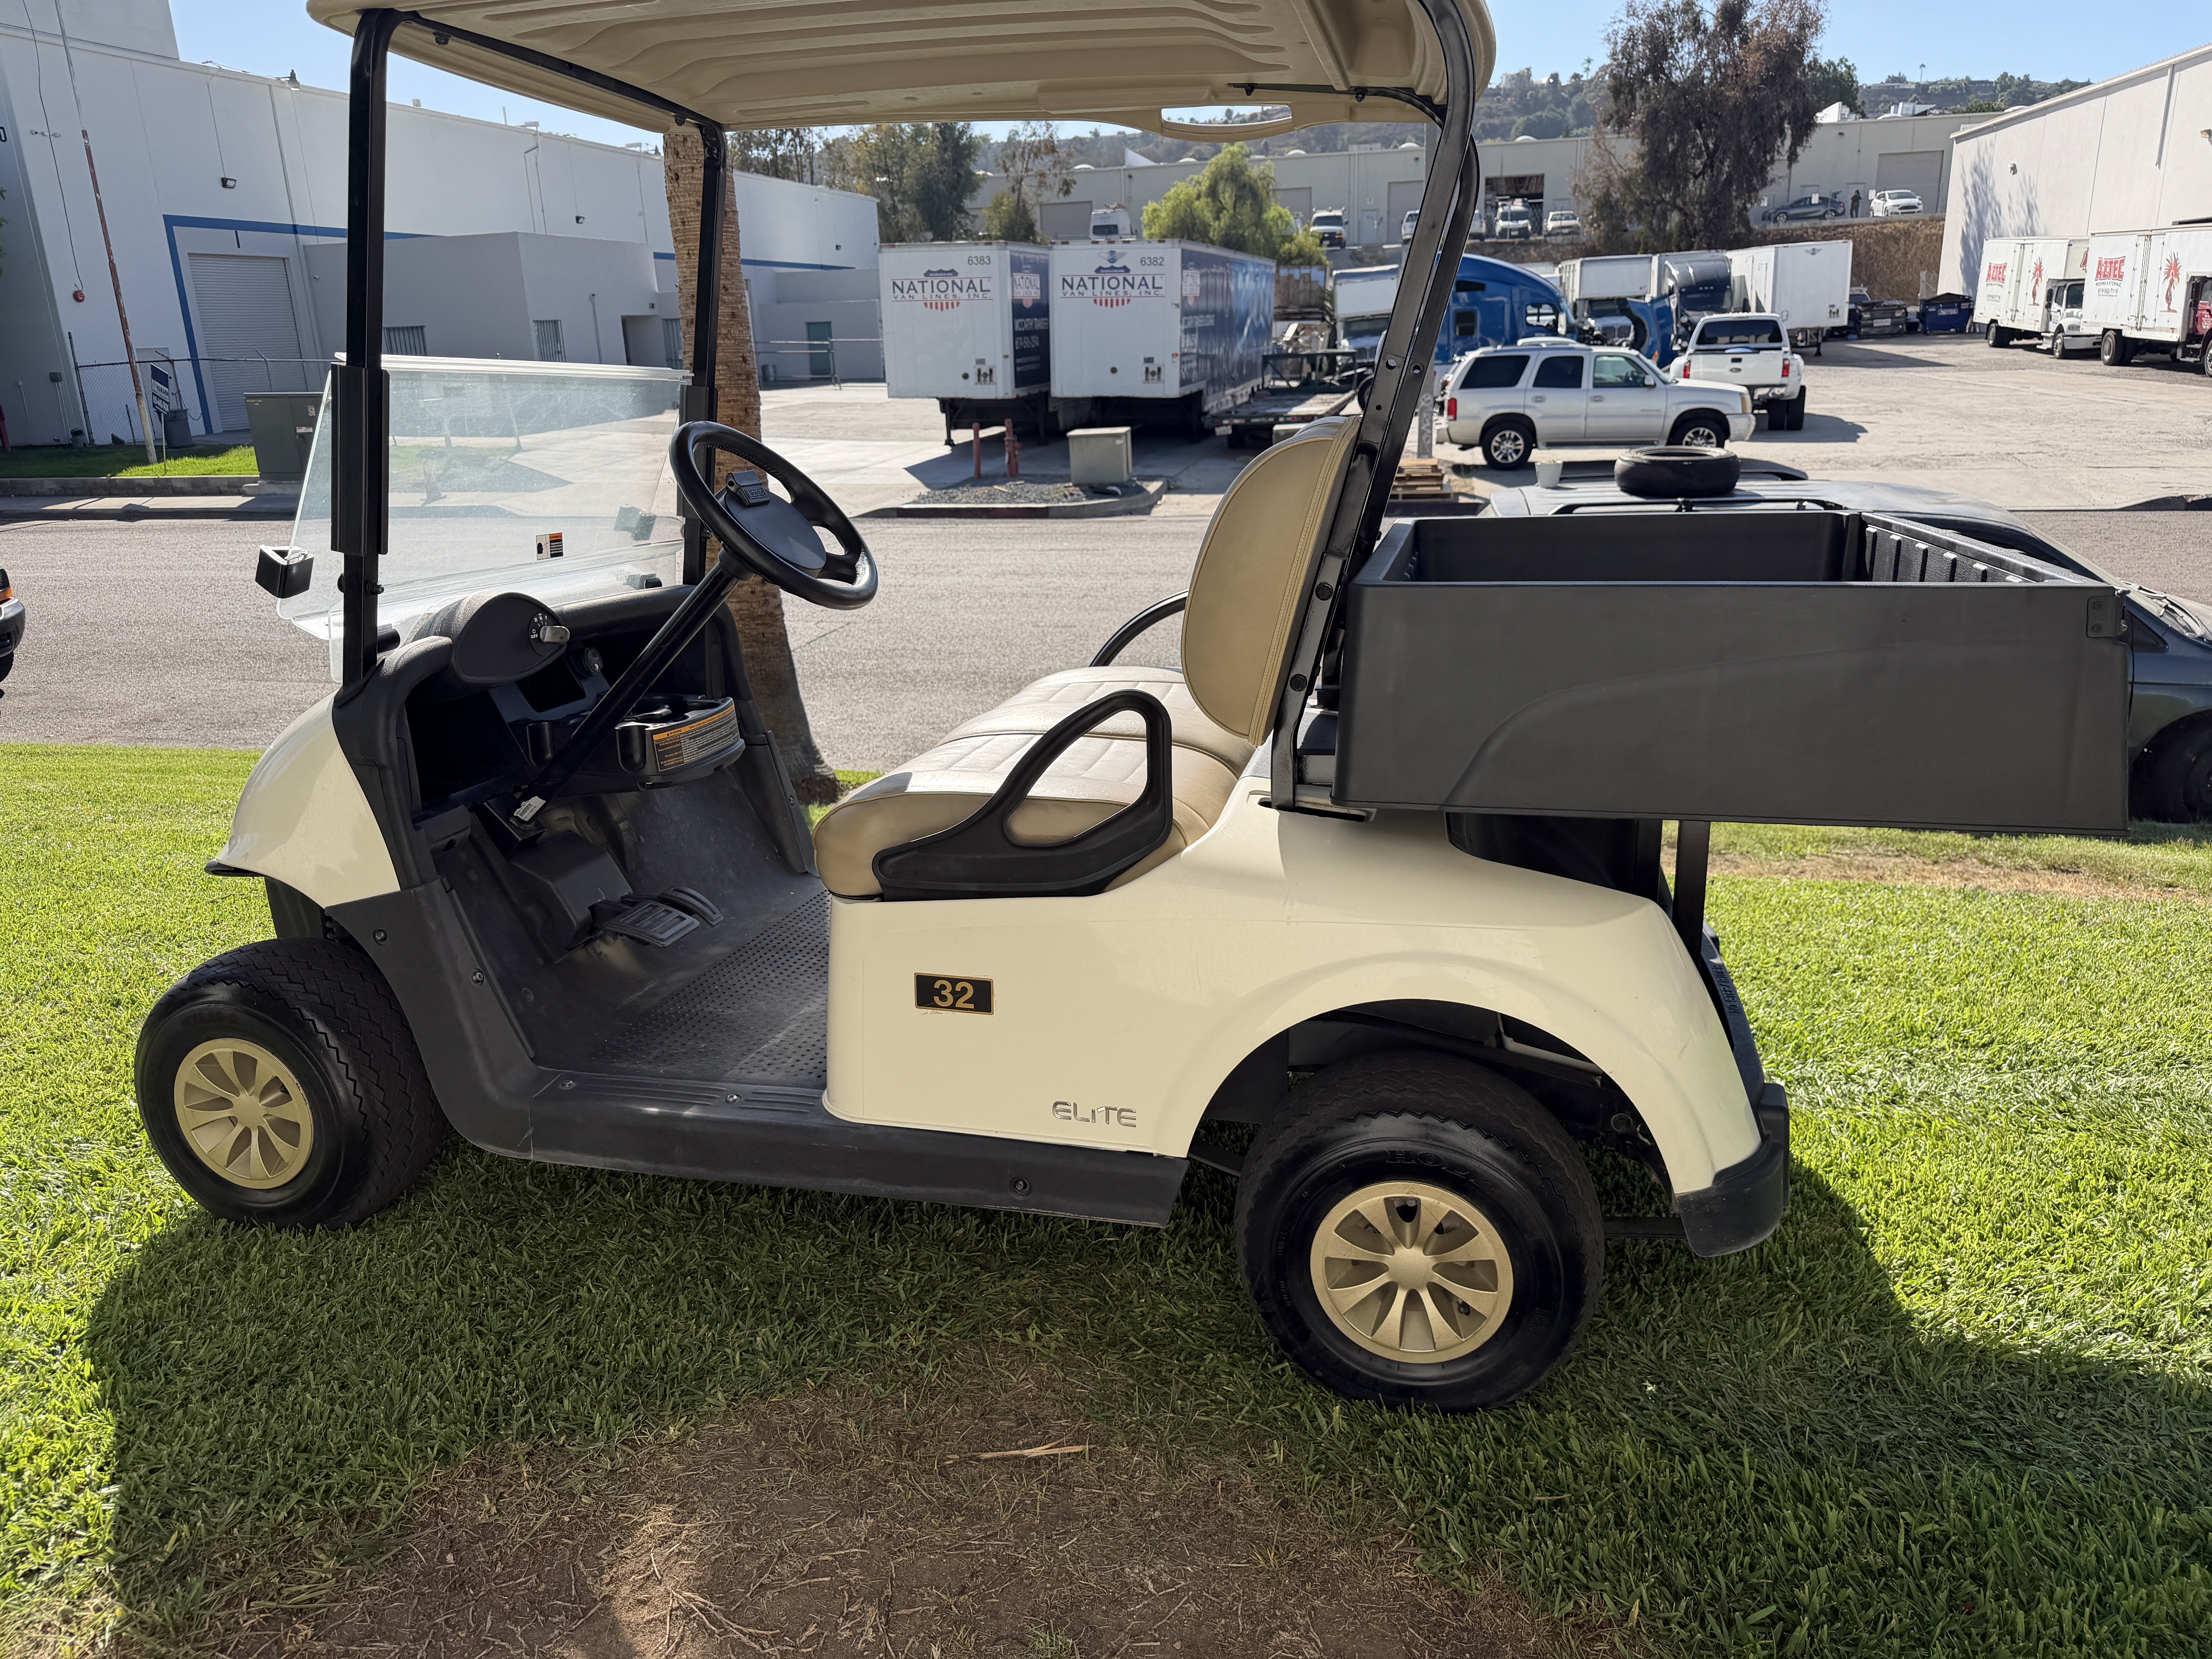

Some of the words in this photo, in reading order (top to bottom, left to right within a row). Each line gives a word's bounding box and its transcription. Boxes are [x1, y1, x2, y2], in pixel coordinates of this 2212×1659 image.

[967, 256, 991, 265] 6383
[1140, 257, 1164, 266] 6382
[1985, 262, 2008, 284] AZTEC
[2095, 256, 2126, 282] AZTEC
[892, 279, 991, 294] NATIONAL
[1062, 276, 1163, 291] NATIONAL
[933, 979, 975, 1009] 32
